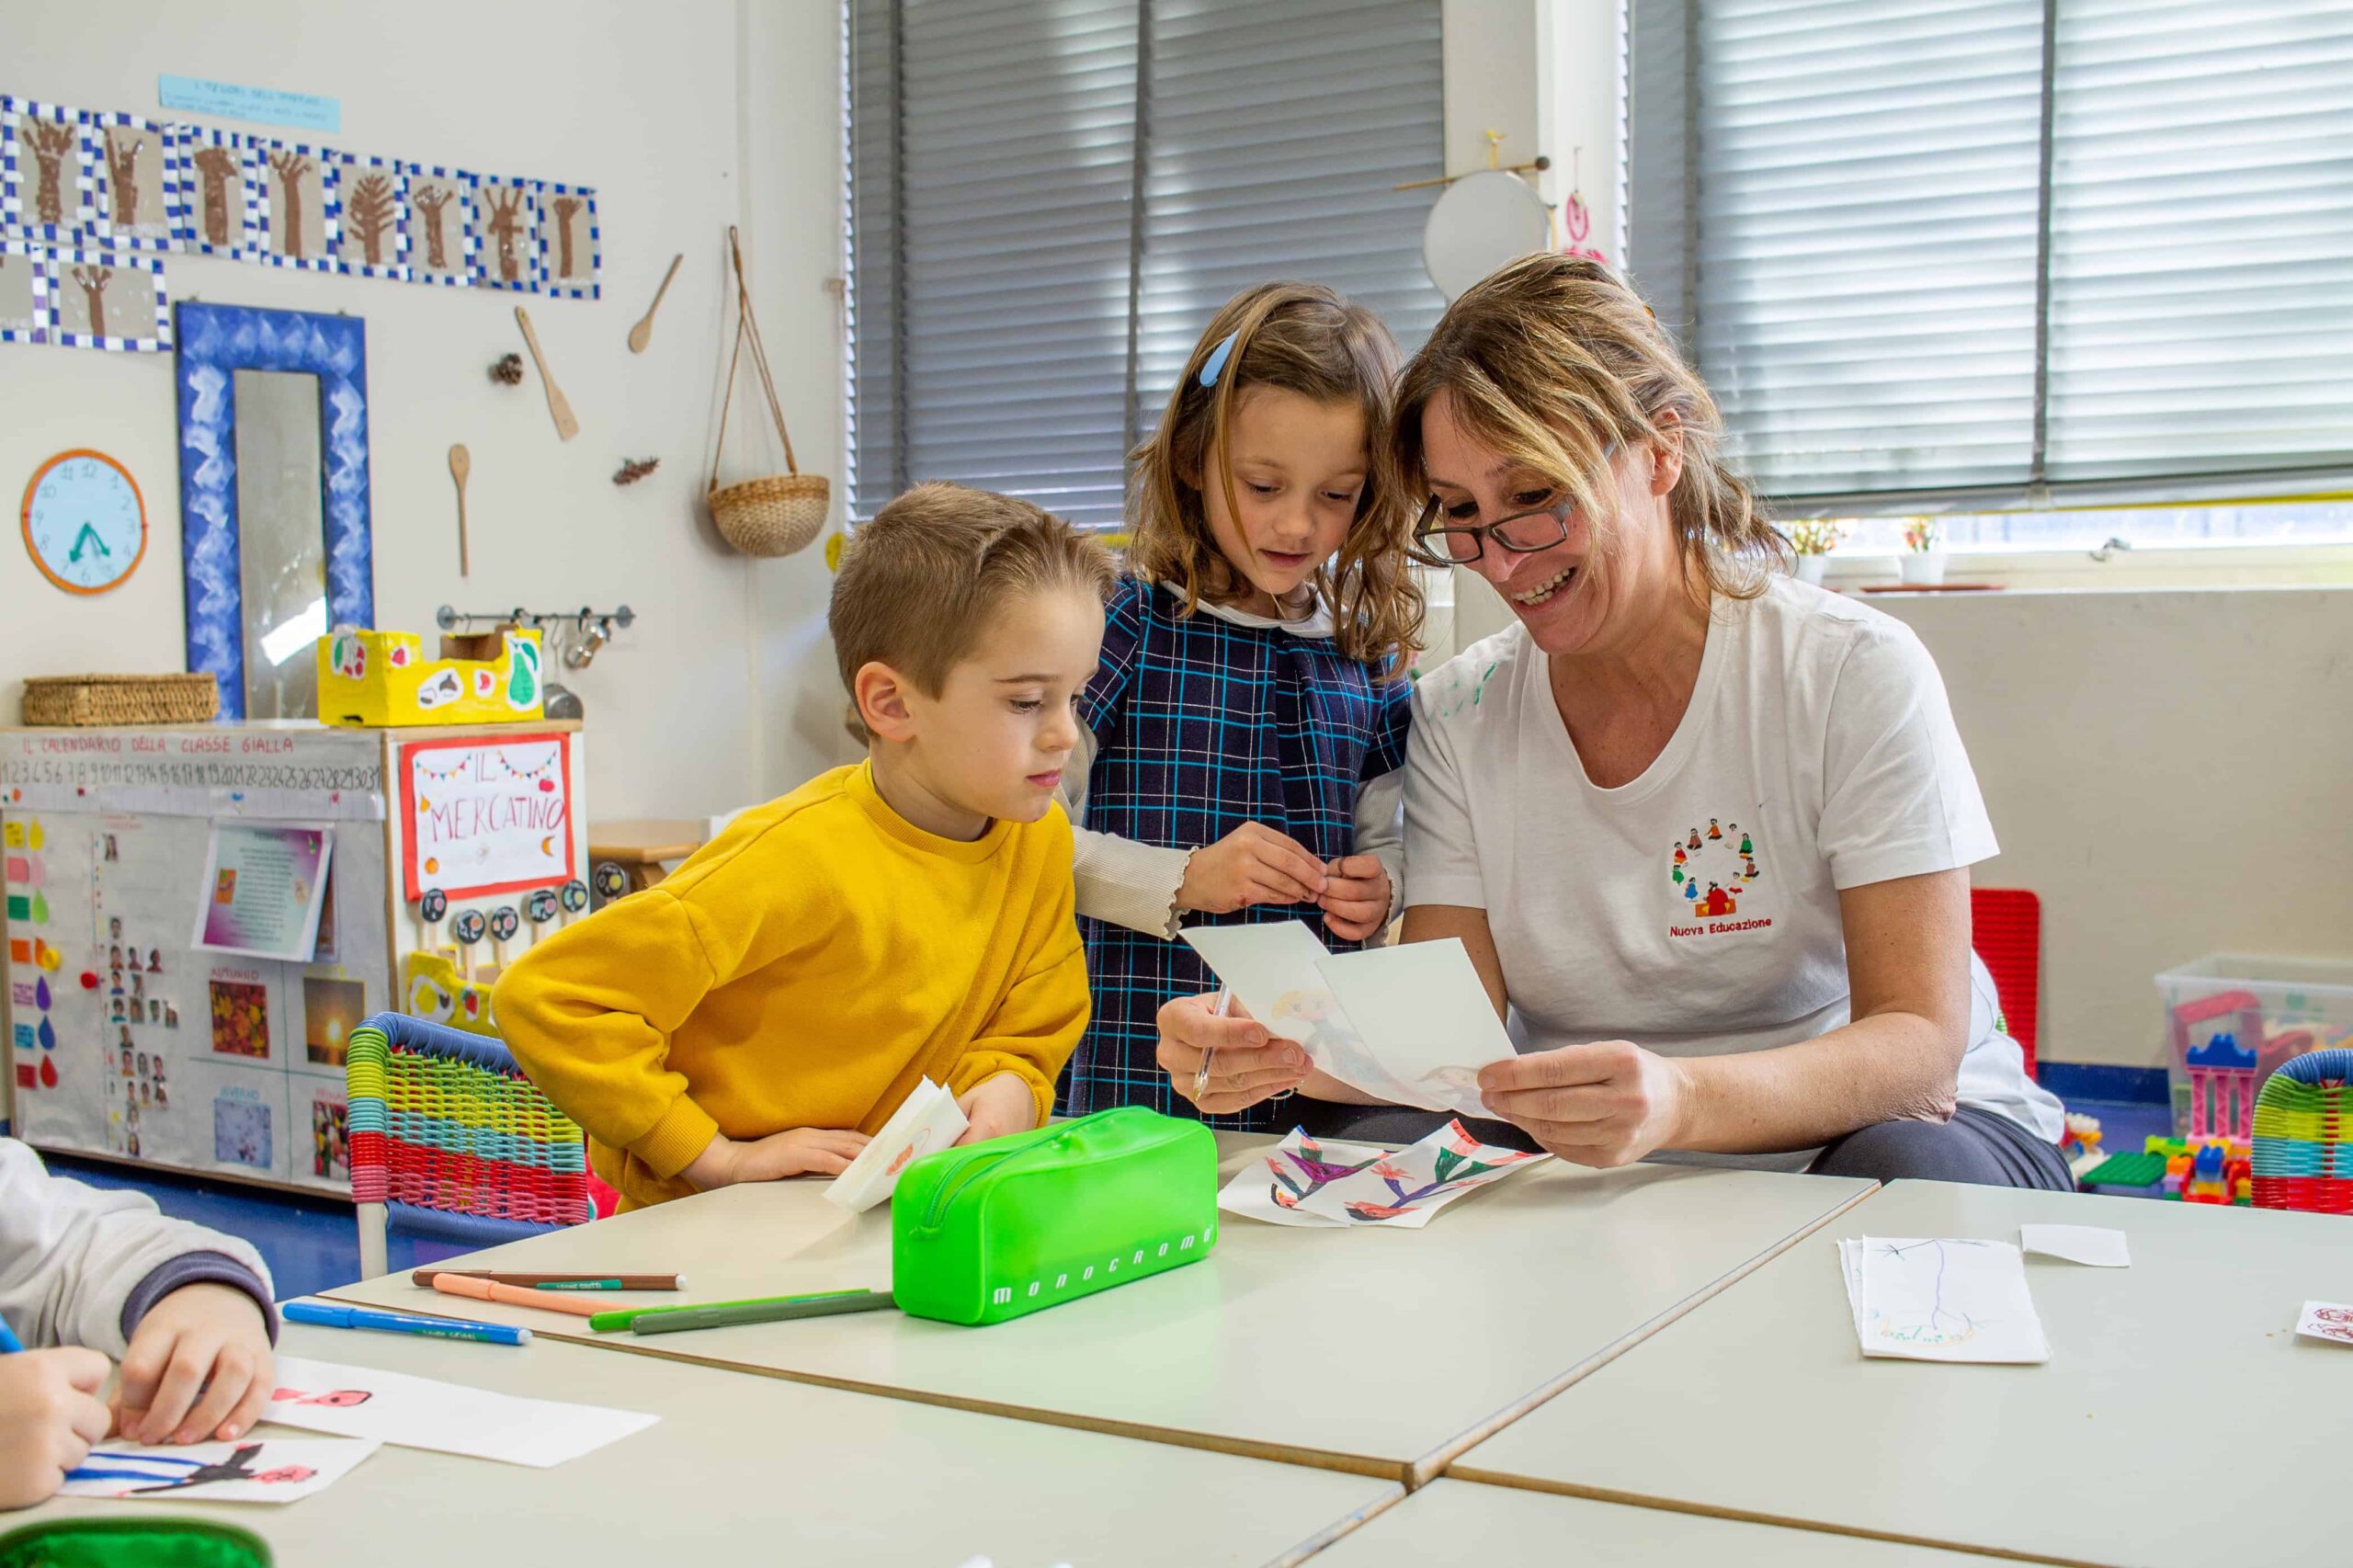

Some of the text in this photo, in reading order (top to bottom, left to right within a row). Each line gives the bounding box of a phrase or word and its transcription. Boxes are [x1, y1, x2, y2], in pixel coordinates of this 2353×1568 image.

[23, 736, 294, 755] IL CALENDARIO DELLA CLASSE GIALLA
[474, 752, 497, 784] IL
[430, 794, 566, 843] MERCATINO
[1669, 918, 1772, 937] Nuova Educazione
